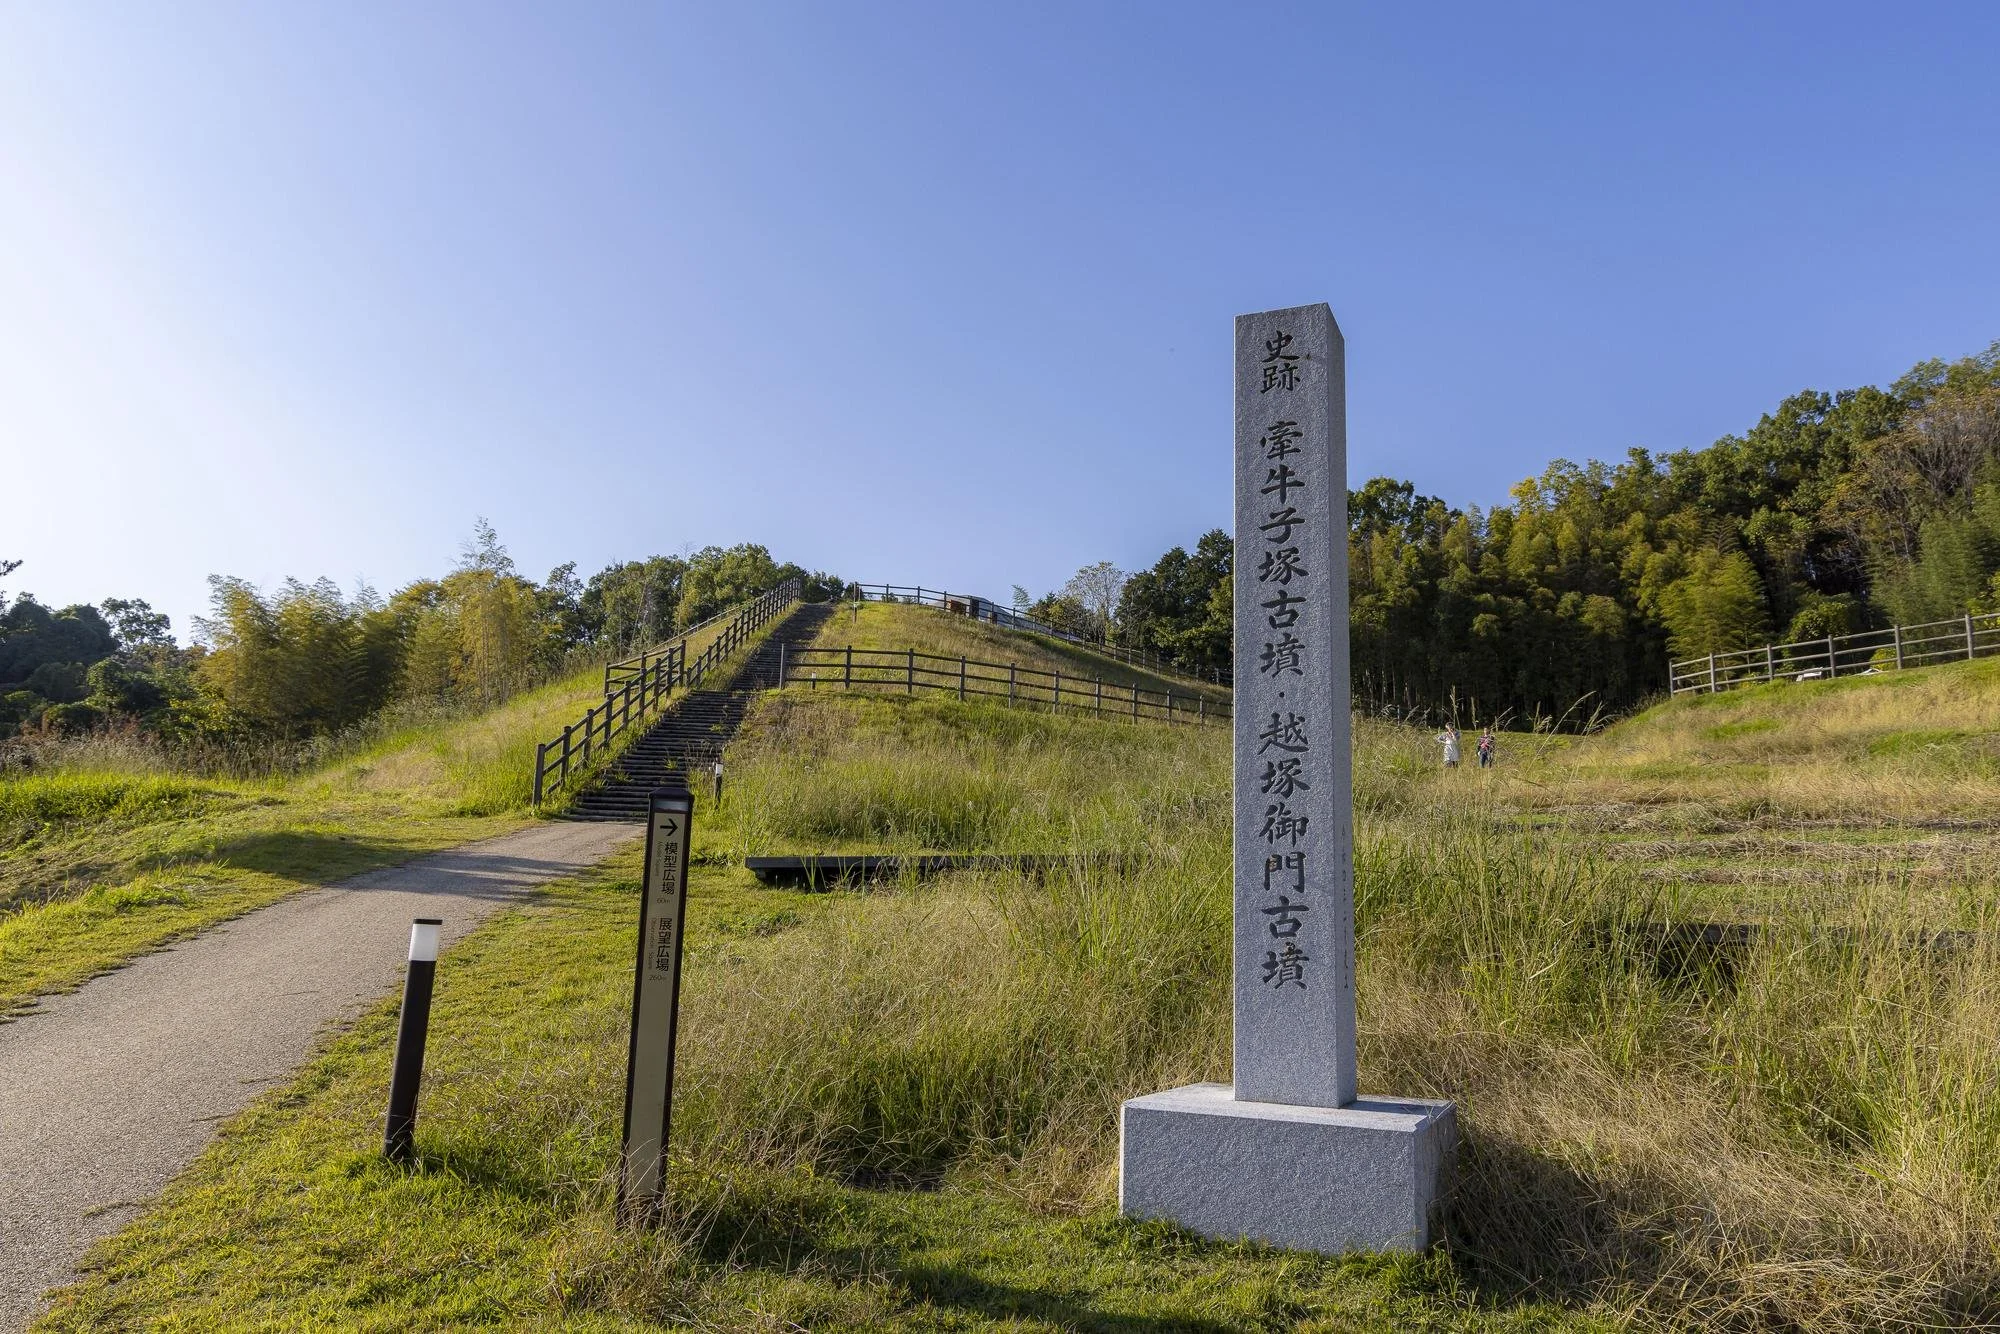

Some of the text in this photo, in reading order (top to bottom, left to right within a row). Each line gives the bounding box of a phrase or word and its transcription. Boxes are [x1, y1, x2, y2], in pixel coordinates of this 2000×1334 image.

[1261, 330, 1300, 394] 史跡
[662, 841, 678, 895] 模型広場
[656, 917, 672, 971] 展望広場
